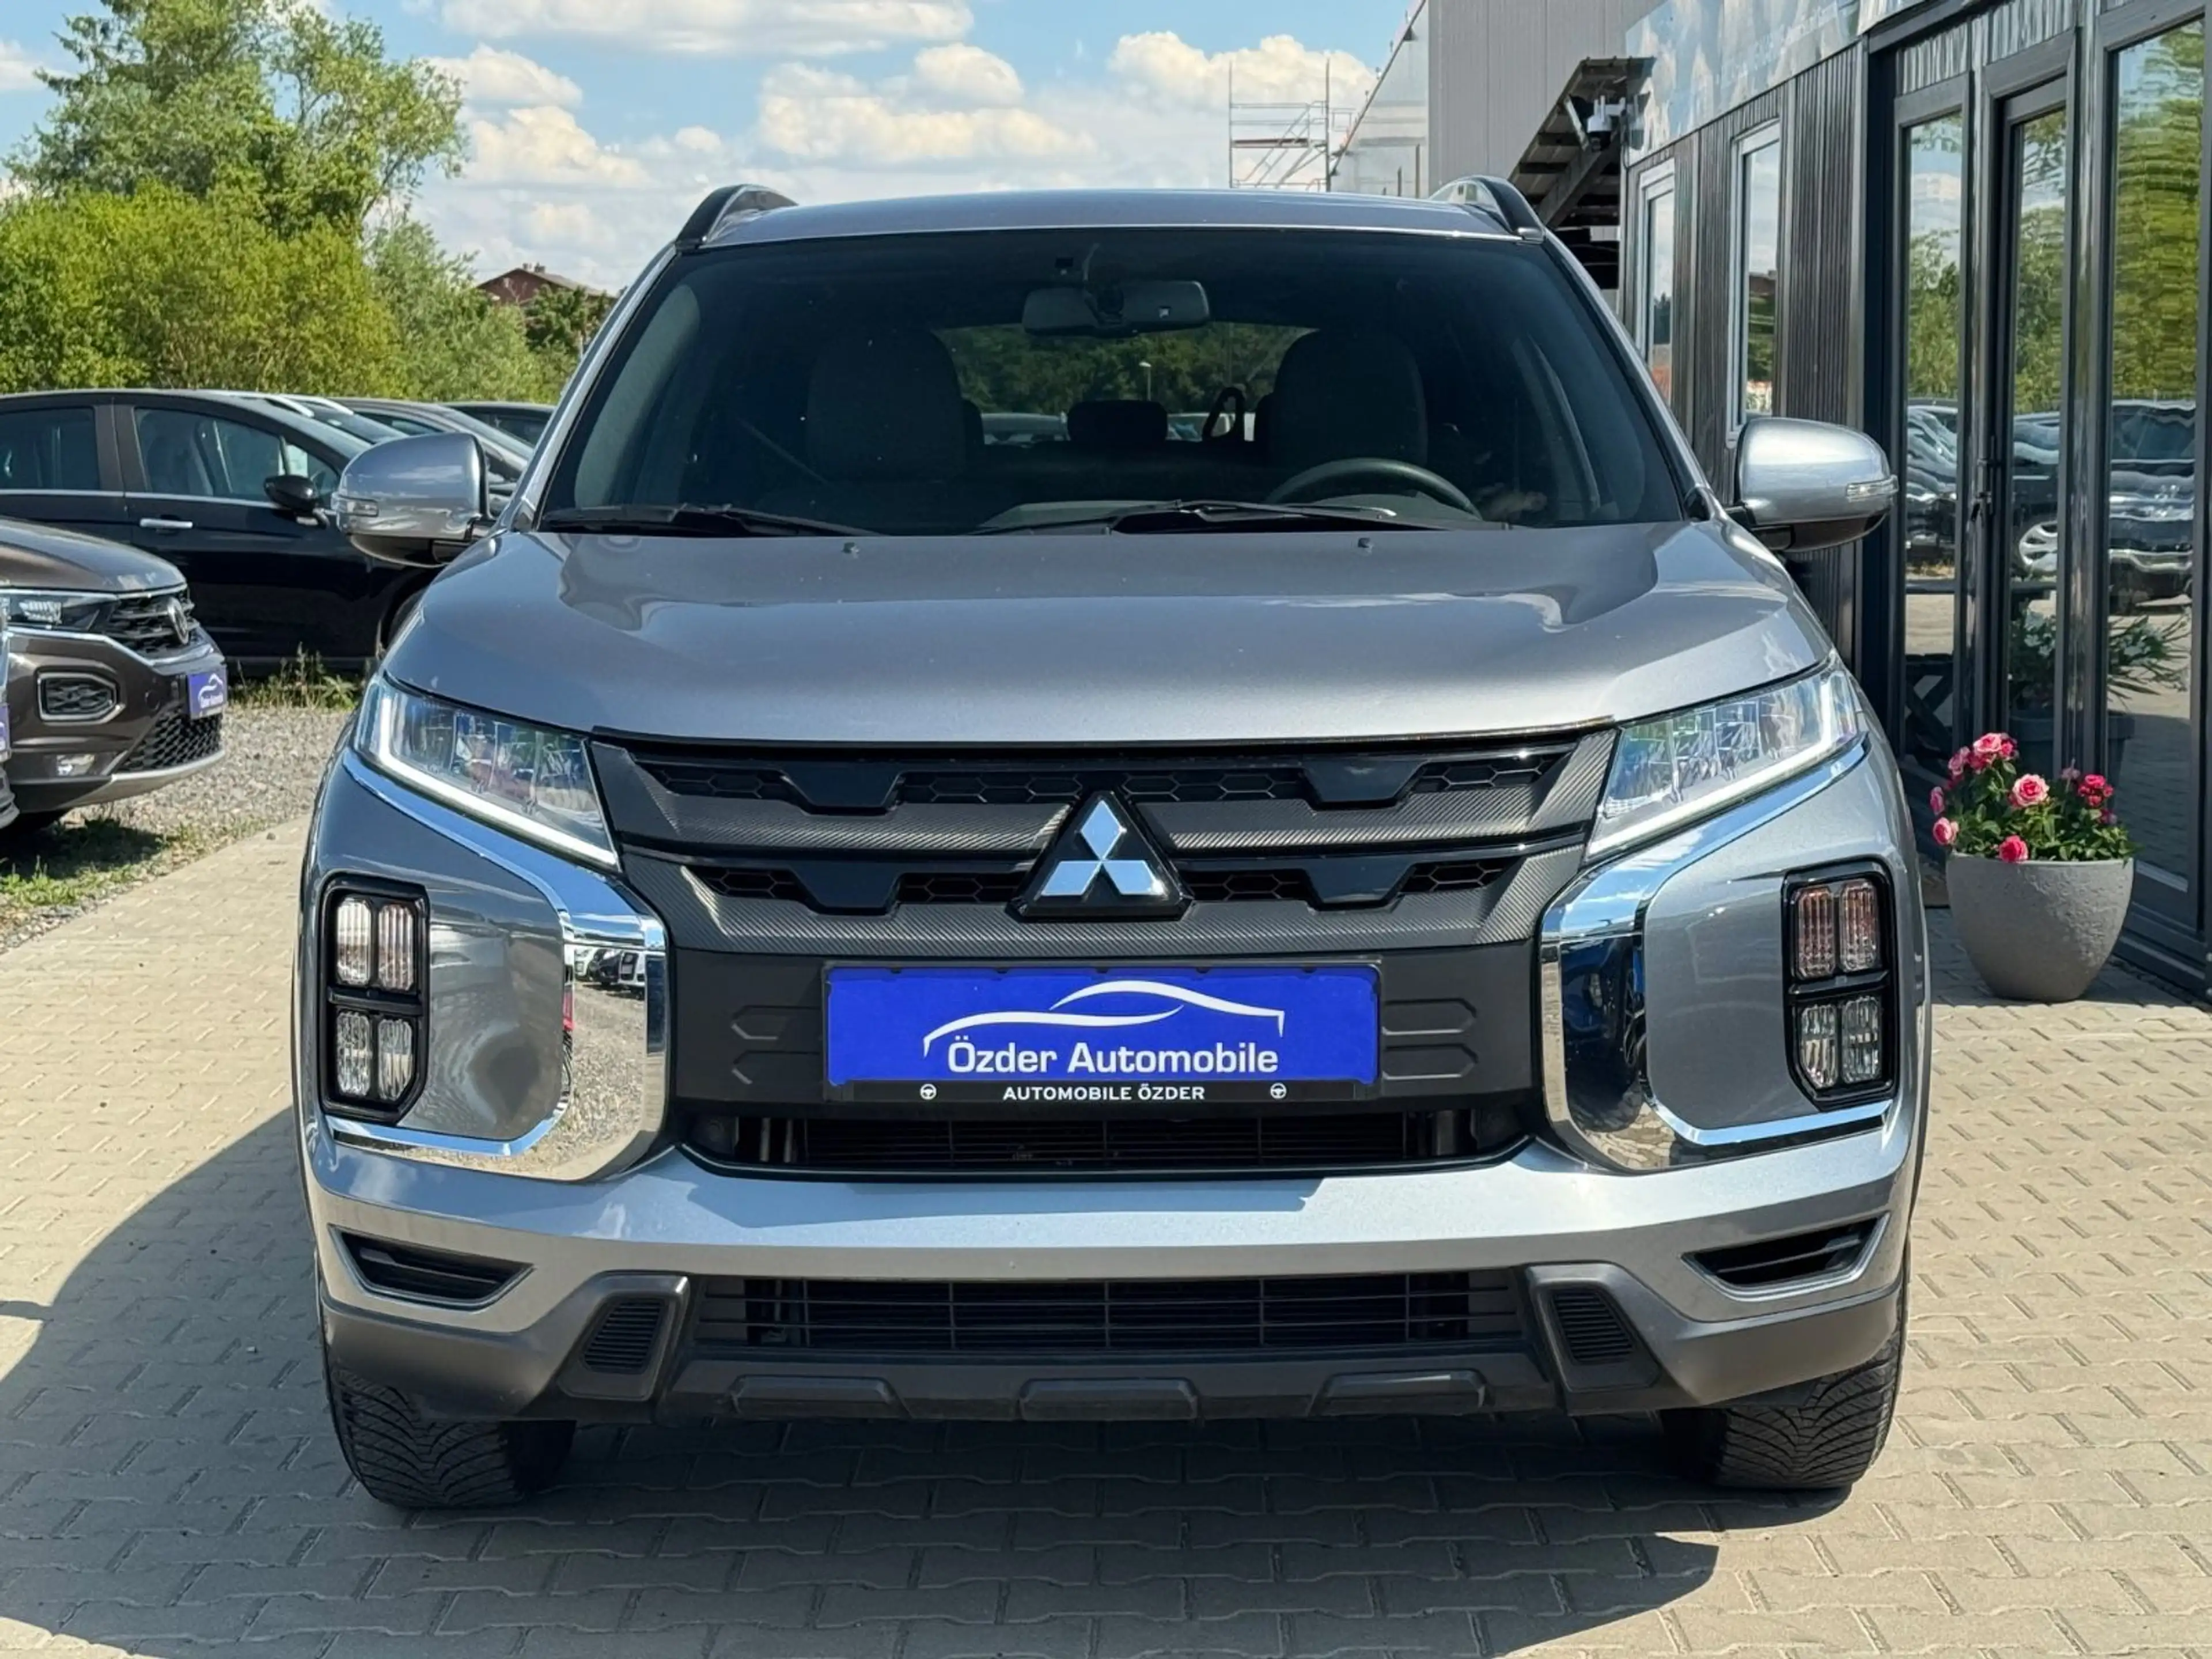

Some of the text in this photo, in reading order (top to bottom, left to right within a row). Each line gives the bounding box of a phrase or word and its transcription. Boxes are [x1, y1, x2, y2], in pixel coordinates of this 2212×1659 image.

[948, 1035, 1278, 1073] Özder Automobile
[1002, 1082, 1206, 1101] AUTOMOBILE ÖZDER
